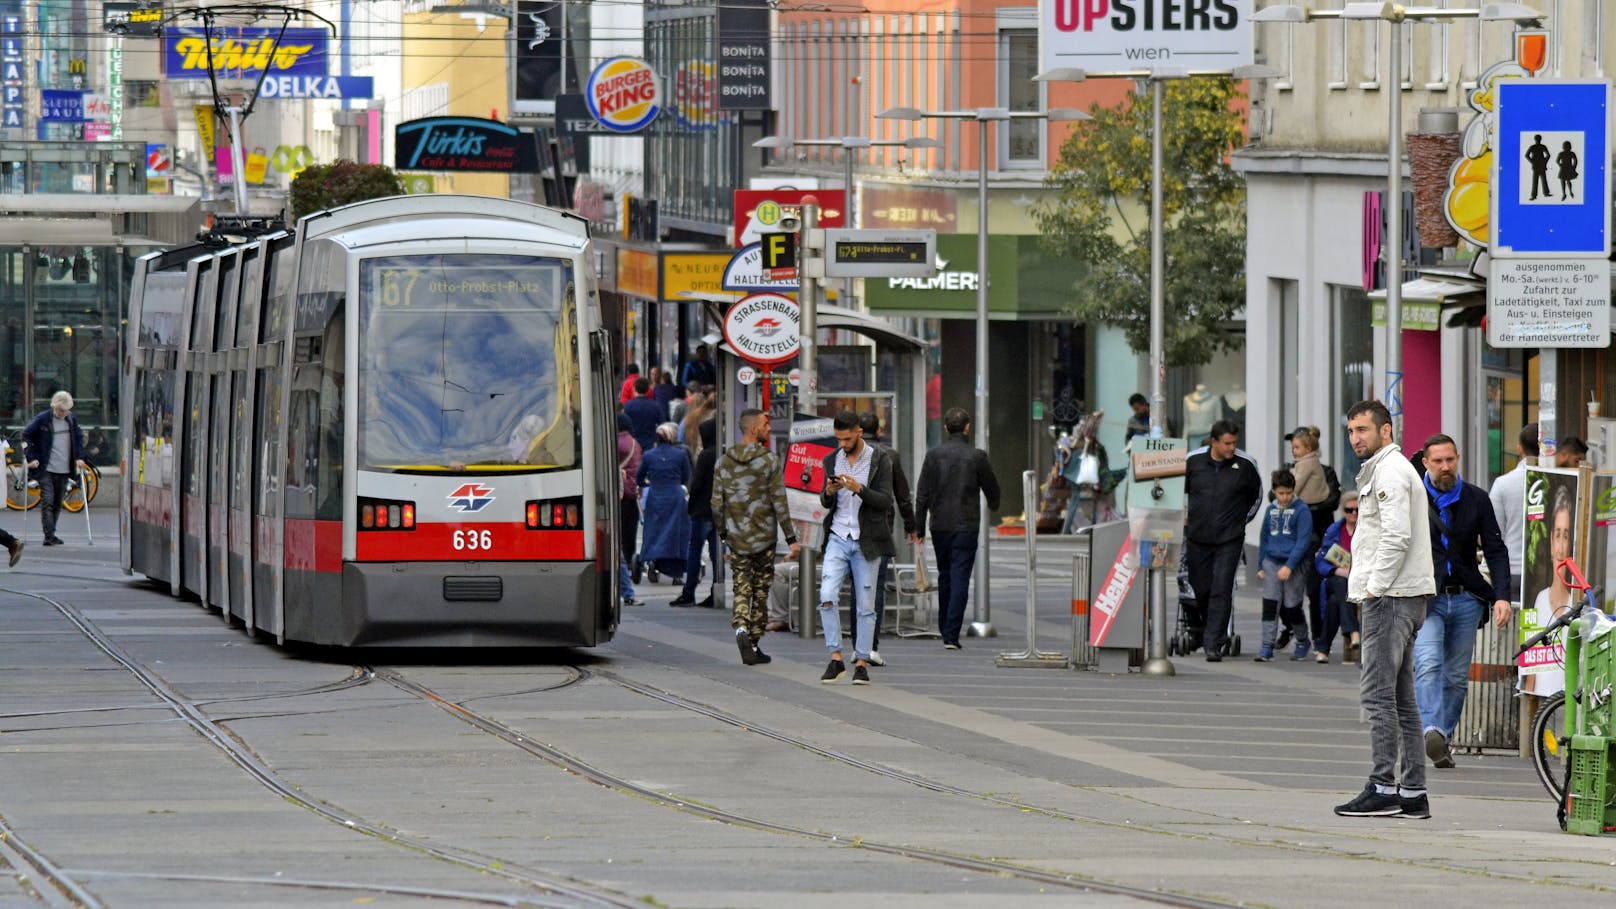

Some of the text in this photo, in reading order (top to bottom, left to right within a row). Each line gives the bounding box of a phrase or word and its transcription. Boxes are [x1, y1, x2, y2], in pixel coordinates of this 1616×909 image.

[175, 37, 314, 70] Tchibo
[1125, 48, 1170, 60] wien
[260, 76, 342, 98] DELKA
[596, 69, 653, 99] BURGER
[599, 81, 656, 118] KING
[763, 205, 775, 219] H
[770, 235, 786, 267] F
[1515, 263, 1586, 273] ausgenommen
[383, 269, 420, 306] 67
[429, 280, 541, 294] Otto-Probst-Platz
[1523, 286, 1577, 295] Zufahrt zur
[1494, 297, 1606, 308] Ladetätigkeit, Taxi zum
[734, 300, 801, 324] STRASSENBAHN
[1507, 309, 1593, 320] Aus- u. Einsteigen
[736, 334, 799, 355] HALTESTELLE
[1499, 333, 1516, 342] der
[739, 371, 754, 381] 67
[791, 443, 807, 456] Gut
[1145, 439, 1175, 452] Hier
[790, 455, 800, 464] zu
[1524, 610, 1537, 625] FÜR
[1524, 650, 1536, 664] DAS
